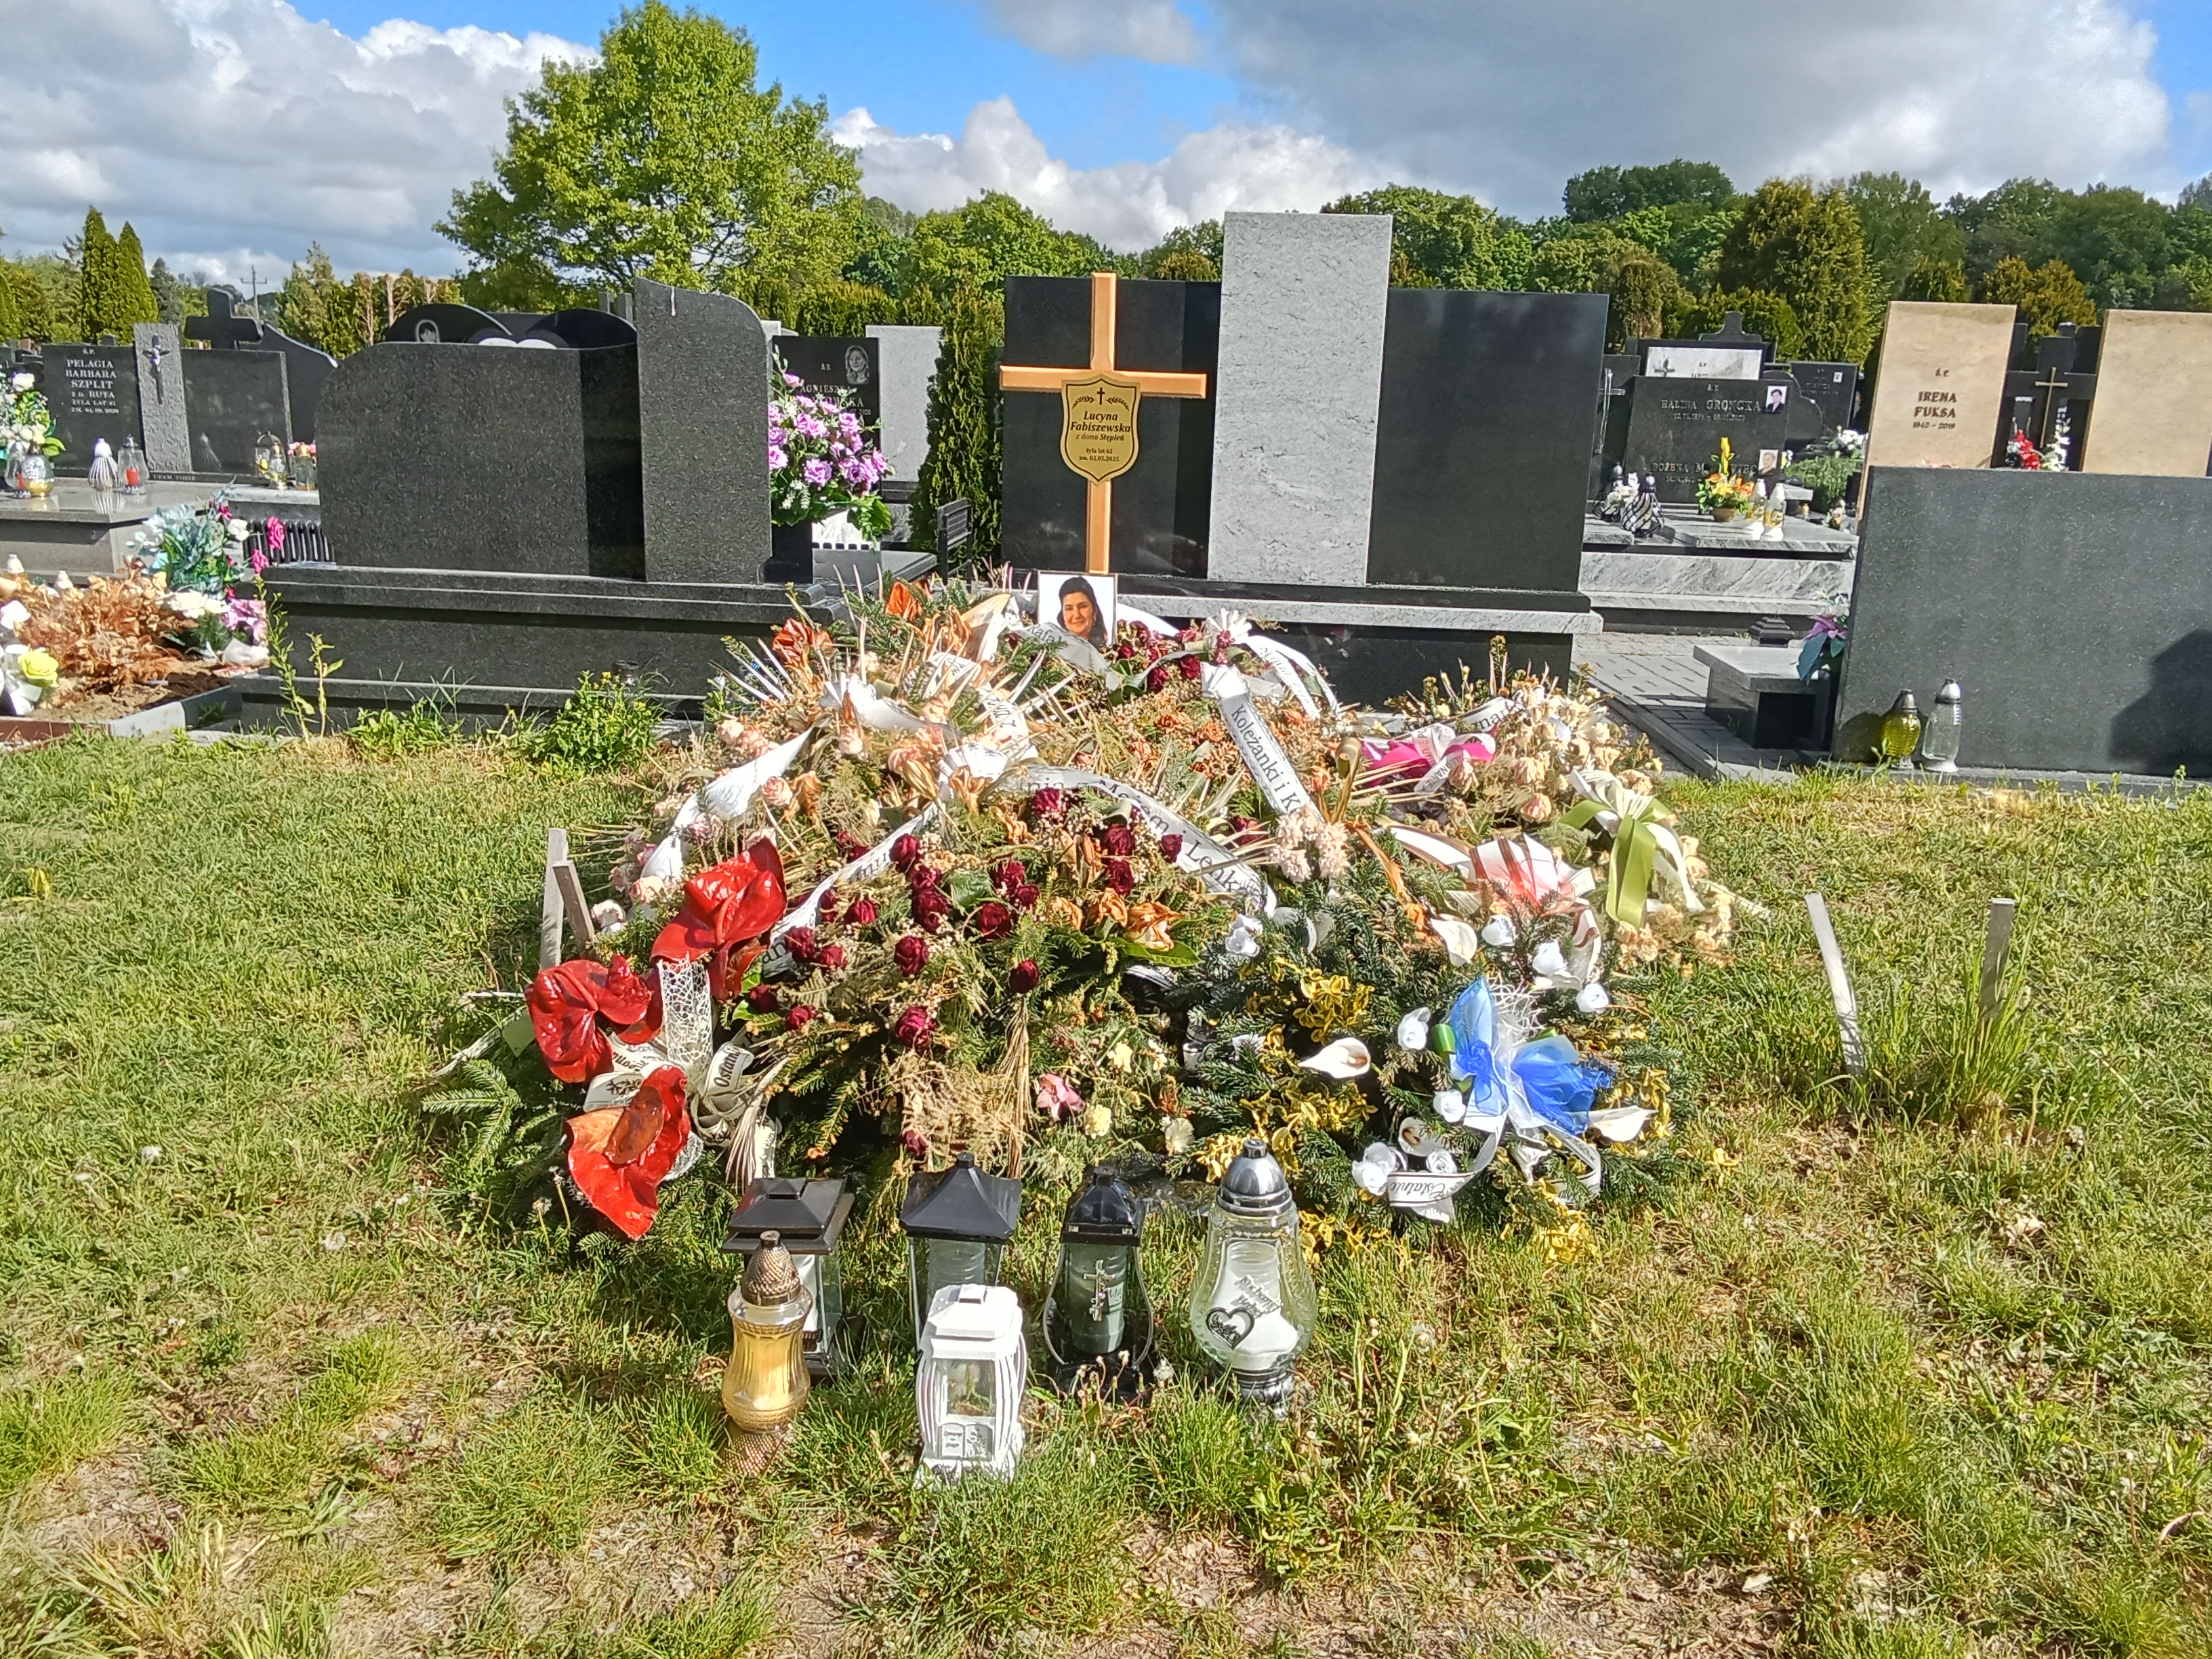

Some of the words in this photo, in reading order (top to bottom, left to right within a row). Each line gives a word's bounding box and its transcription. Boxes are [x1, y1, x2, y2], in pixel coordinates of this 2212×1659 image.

[66, 359, 114, 369] PELAGIA
[65, 369, 117, 378] BARBARA
[71, 380, 113, 389] SZPLIT
[800, 384, 851, 393] AGNIESZ
[89, 390, 115, 398] RUTA
[1917, 391, 1957, 403] IRENA
[1660, 399, 1698, 410] HALINA
[1083, 410, 1118, 424] Lucyna
[1913, 406, 1957, 419] FUKSA
[1070, 421, 1131, 433] Fabiszewska
[1099, 434, 1125, 443] Stępień
[1231, 703, 1280, 783] Koleżanki
[1274, 781, 1290, 794] i
